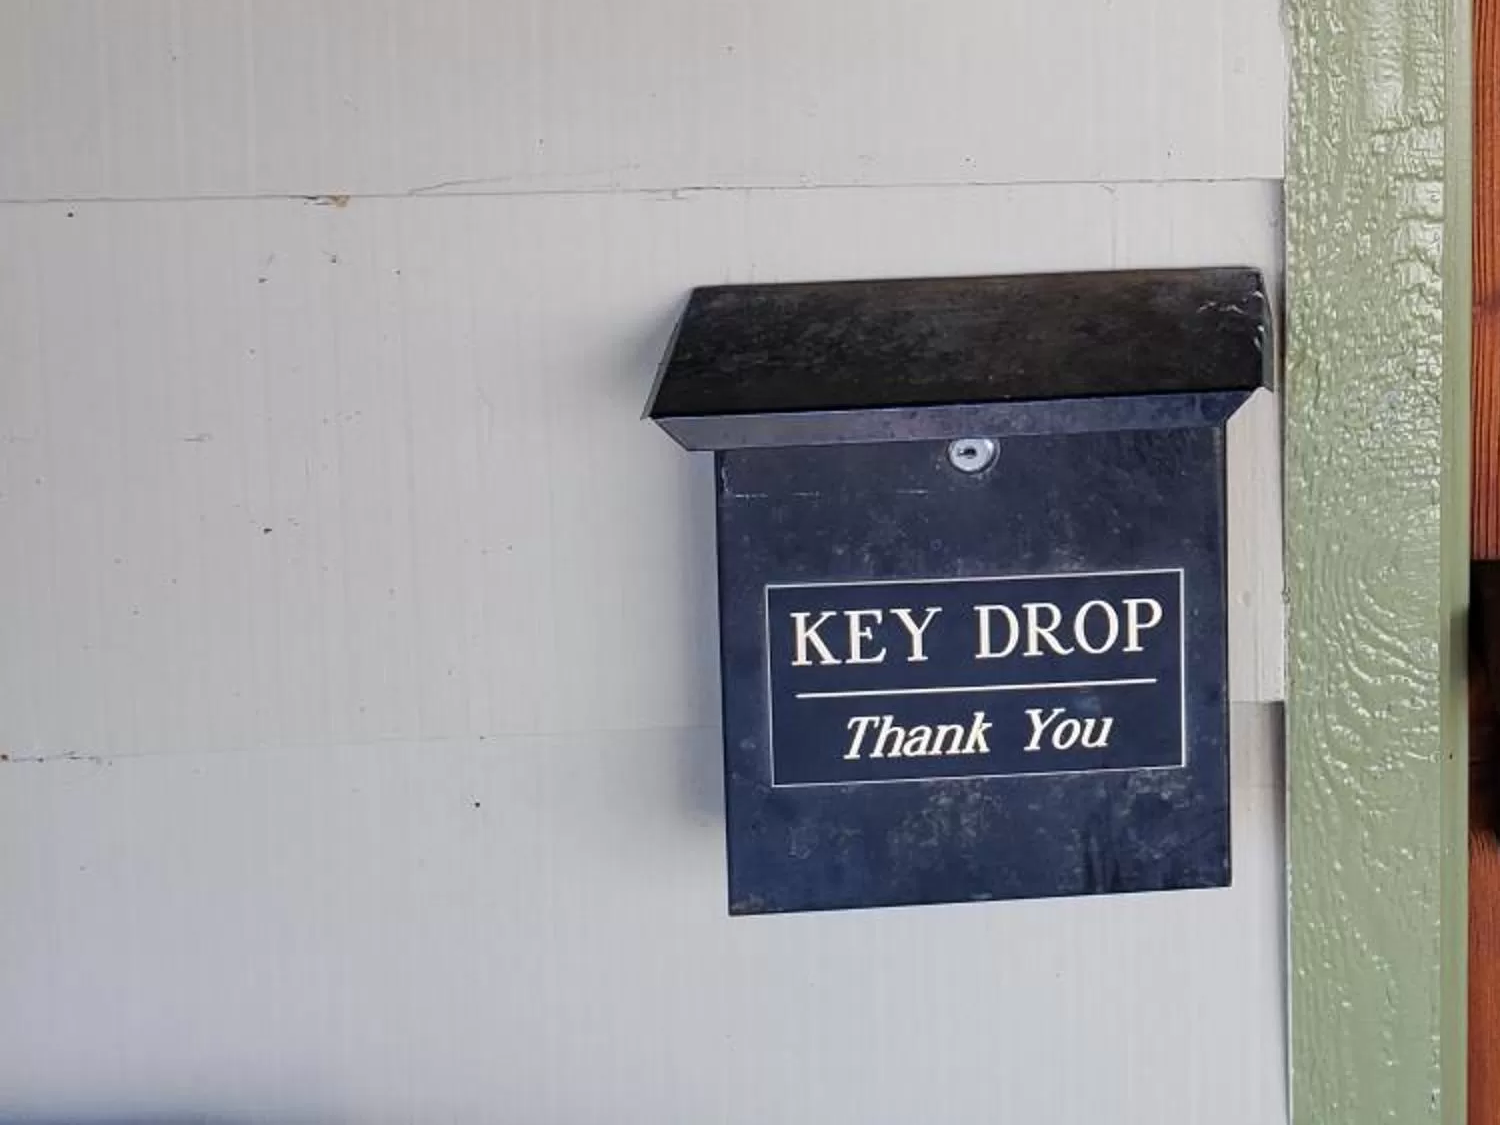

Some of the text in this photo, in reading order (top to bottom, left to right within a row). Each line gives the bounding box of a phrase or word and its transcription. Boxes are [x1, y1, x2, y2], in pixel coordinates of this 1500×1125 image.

[790, 598, 1164, 666] KEY DROP
[843, 708, 1114, 760] Thank You
